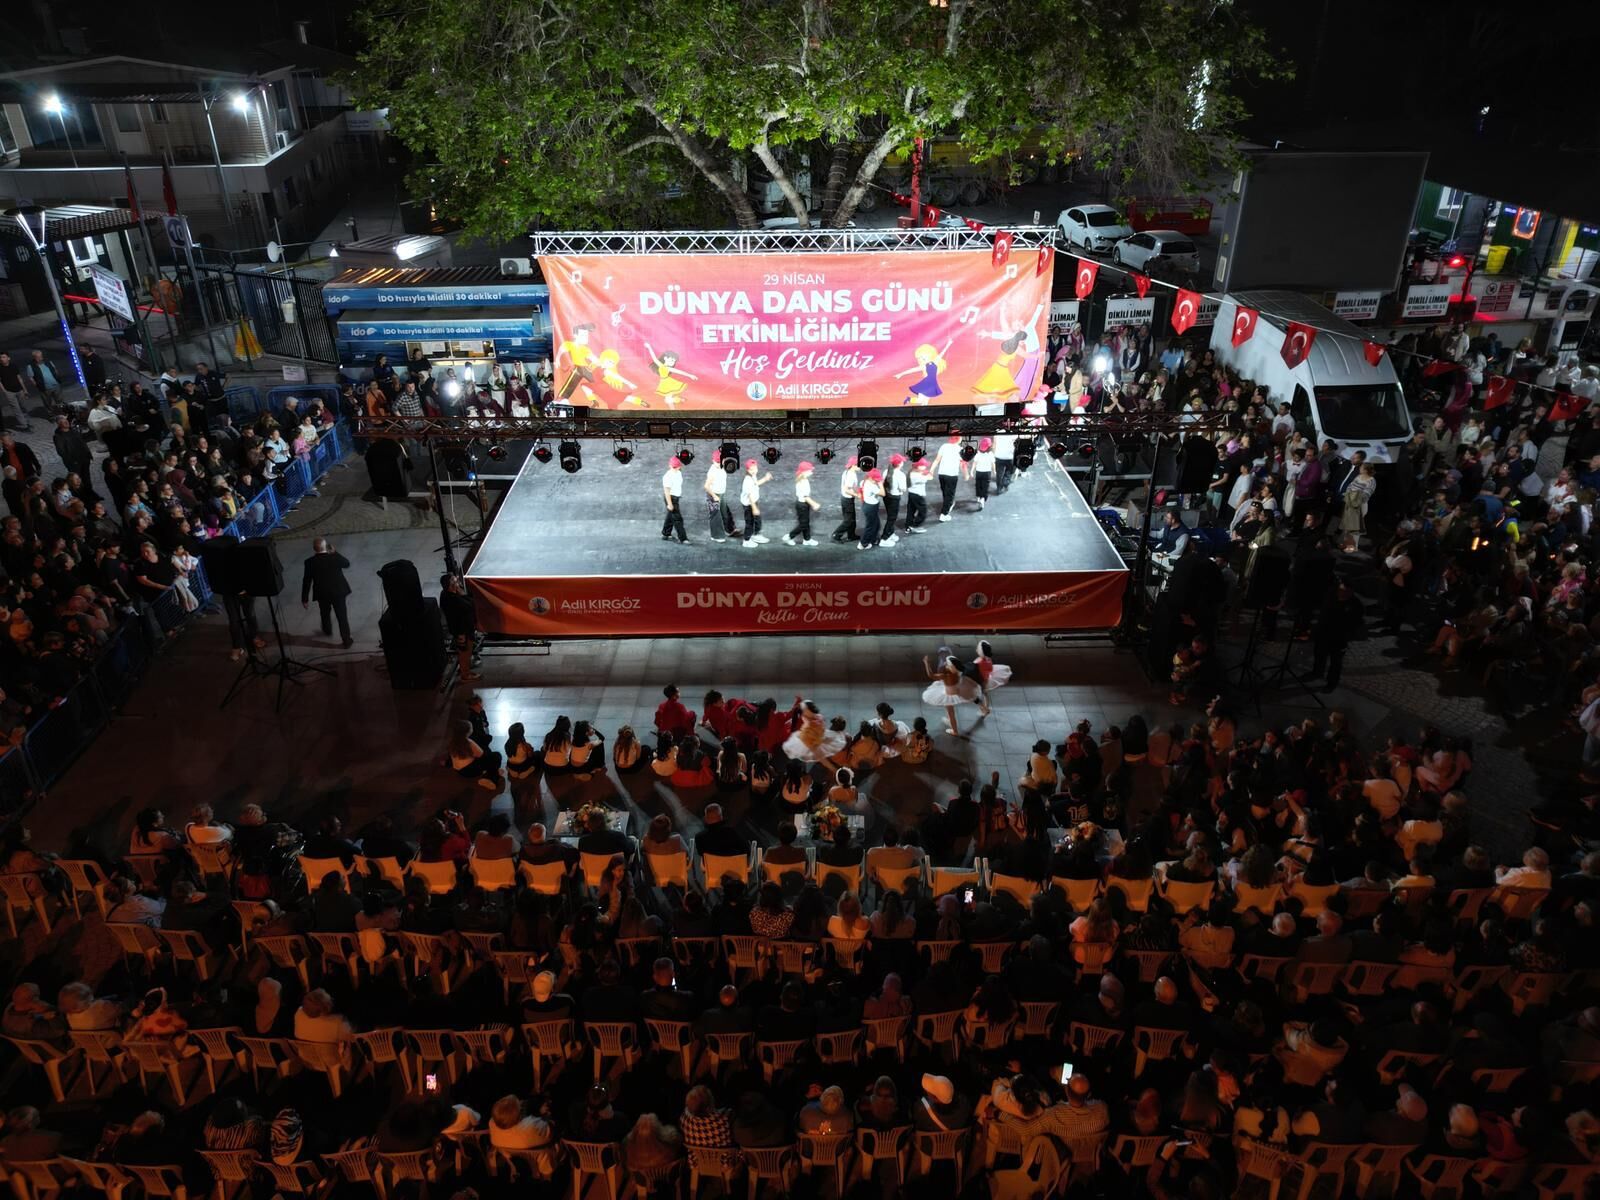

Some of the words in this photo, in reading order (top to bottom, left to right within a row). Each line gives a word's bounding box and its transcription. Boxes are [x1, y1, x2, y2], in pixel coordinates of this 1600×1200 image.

[763, 273, 779, 286] 29
[783, 271, 825, 286] NİSAN
[328, 295, 341, 303] ido
[427, 292, 454, 302] Midilli
[455, 293, 467, 301] 30
[467, 292, 502, 301] dakika!
[639, 284, 755, 315] DÜNYA
[762, 289, 853, 314] DANS
[861, 280, 953, 313] GÜNÜ
[1356, 297, 1378, 307] LİMAN
[1428, 295, 1448, 304] LİMAN
[1054, 312, 1076, 322] LİMAN
[1108, 310, 1129, 319] DİKİLİ
[1129, 308, 1152, 318] LİMAN
[351, 328, 366, 336] ido
[702, 316, 892, 343] ETKİNLİĞİMİZE
[719, 346, 770, 379] Hoş
[775, 347, 874, 379] Geldiniz
[775, 383, 799, 395] Adil
[801, 381, 849, 395] KIRGÖZ
[784, 582, 794, 590] 29
[560, 599, 586, 610] Adil
[589, 596, 641, 610] KIRGÖZ
[676, 587, 770, 609] DÜNYA
[777, 590, 850, 608] DANS
[856, 585, 931, 607] GÜNÜ
[997, 592, 1023, 605] Adil
[757, 608, 799, 625] Kutlu
[803, 607, 850, 623] Olsun
